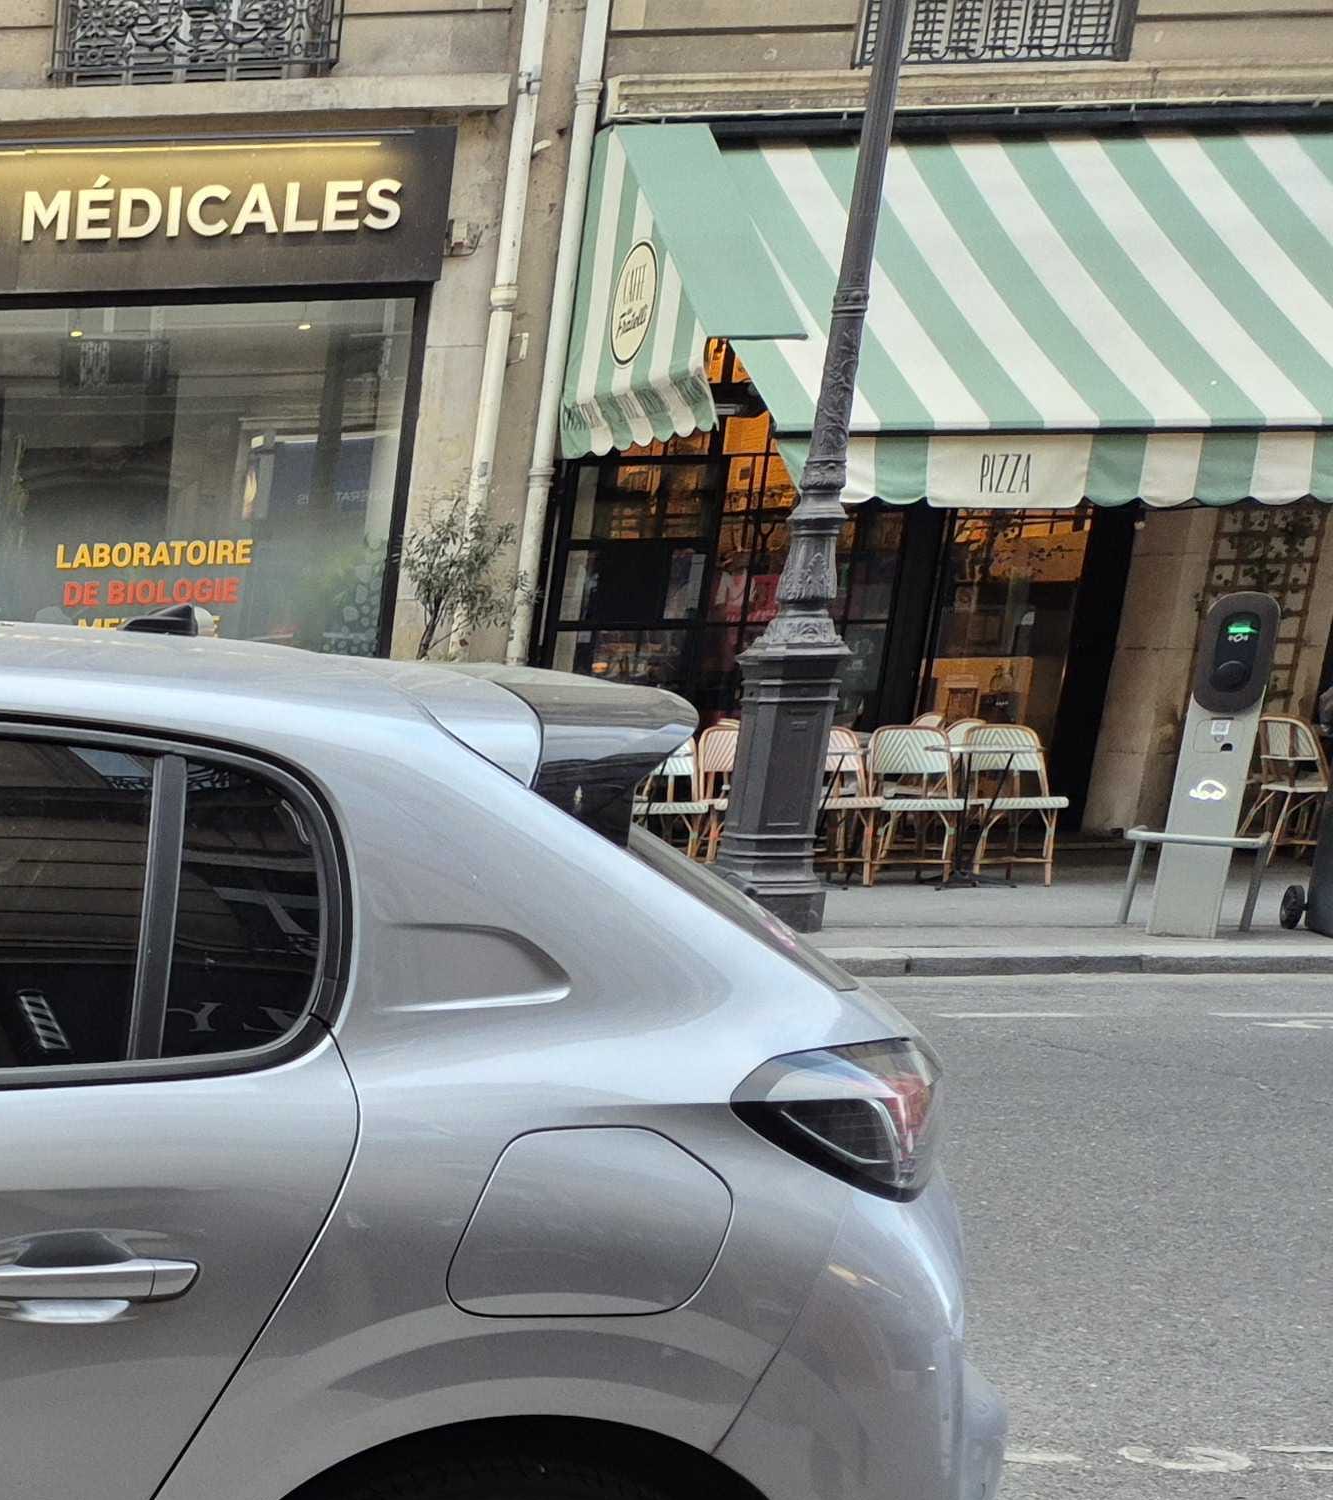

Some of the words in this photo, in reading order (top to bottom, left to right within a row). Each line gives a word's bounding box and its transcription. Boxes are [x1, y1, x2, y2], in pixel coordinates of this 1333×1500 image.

[21, 174, 404, 243] MÉDICALES
[979, 453, 1031, 493] PIZZA
[55, 539, 253, 569] LABORATOIRE
[63, 580, 100, 607] DE
[107, 577, 241, 606] BIOLOGIE
